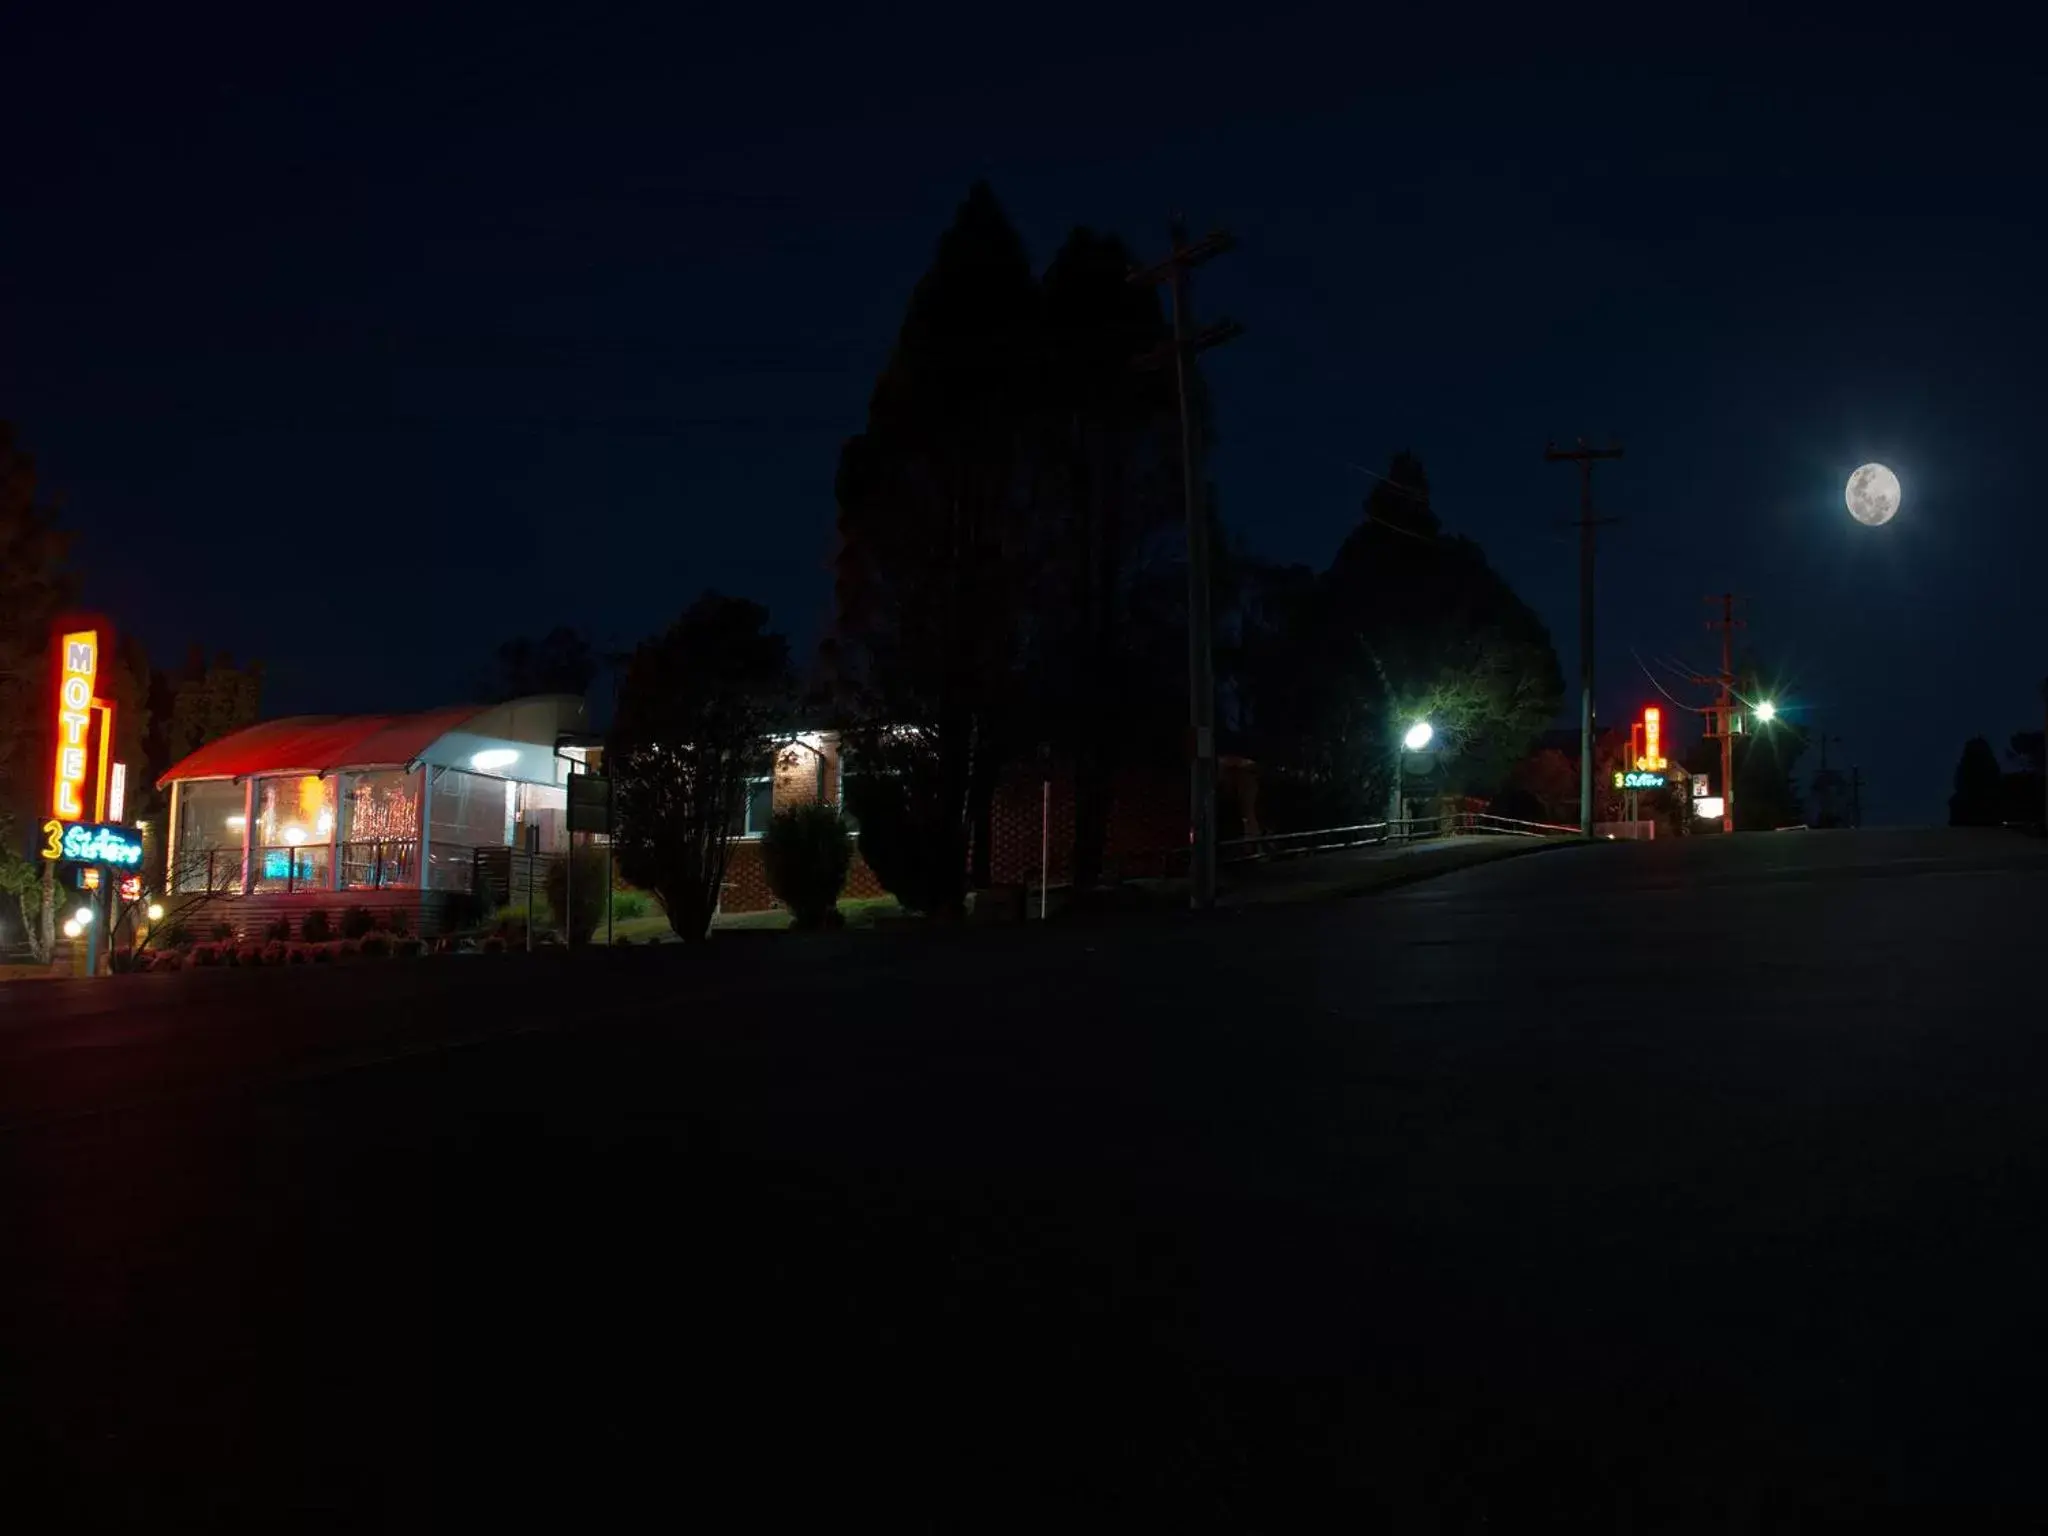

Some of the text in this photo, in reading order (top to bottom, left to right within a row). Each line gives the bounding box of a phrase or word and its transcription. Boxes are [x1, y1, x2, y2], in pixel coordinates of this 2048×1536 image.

[61, 642, 92, 812] MOTEL
[1614, 772, 1624, 787] 3
[42, 820, 63, 859] 3
